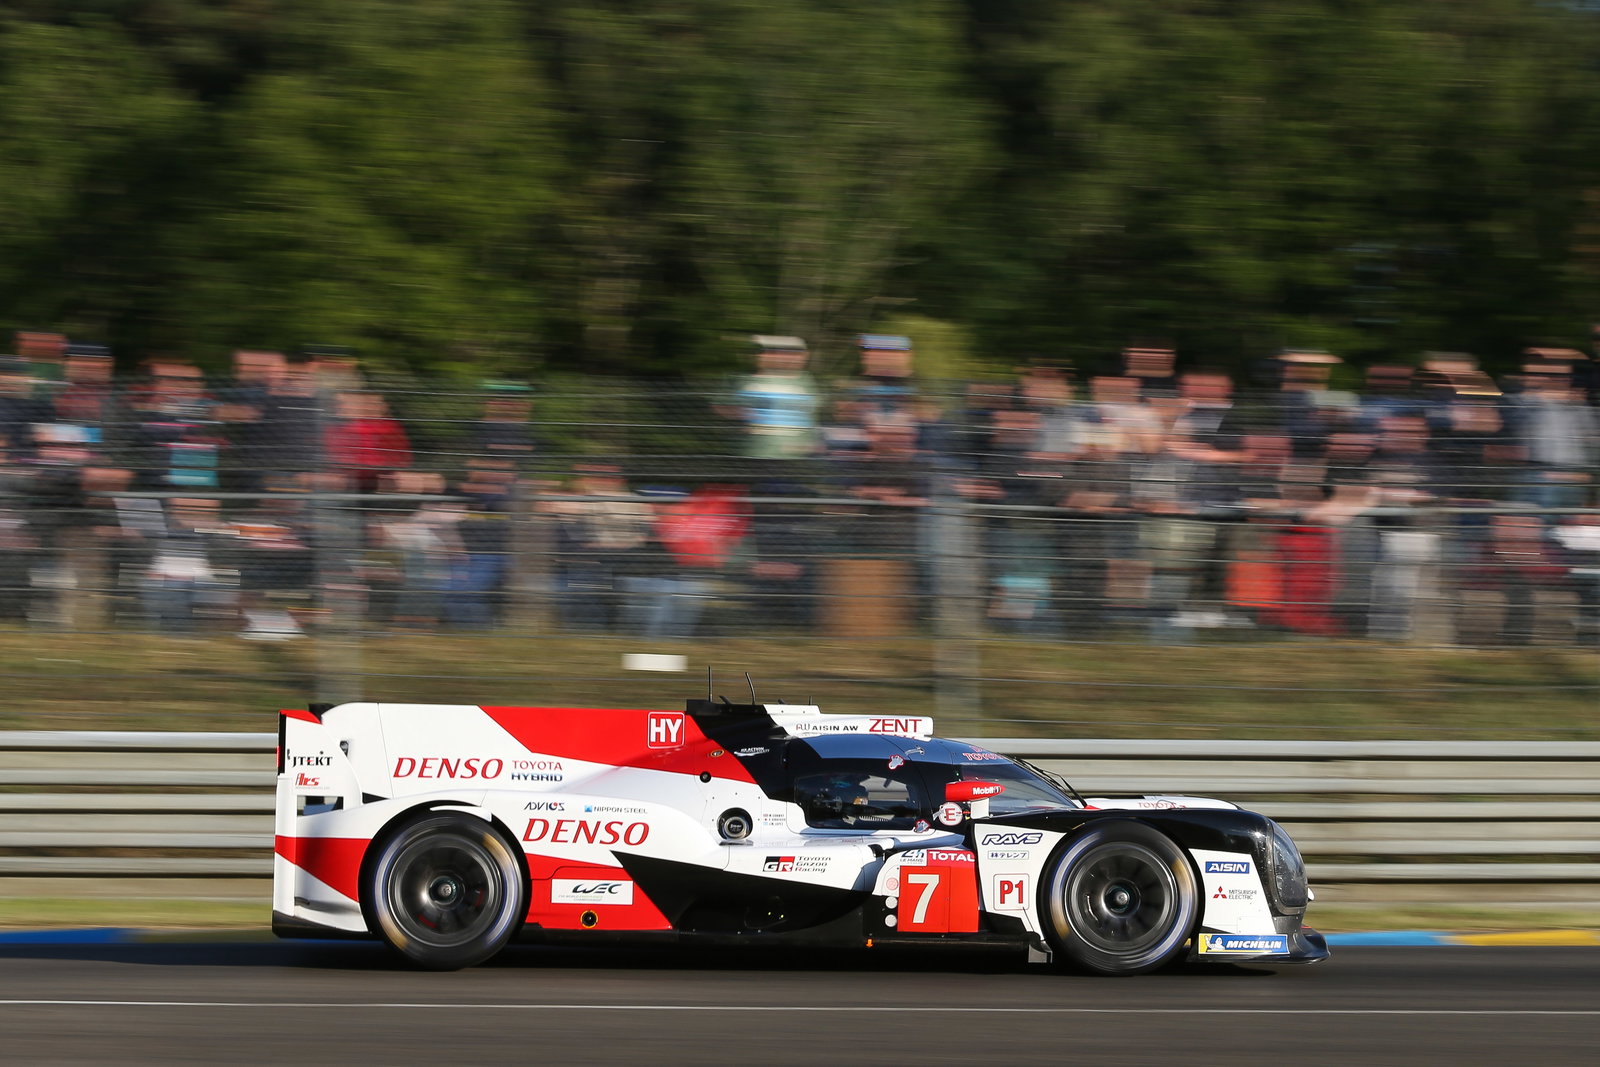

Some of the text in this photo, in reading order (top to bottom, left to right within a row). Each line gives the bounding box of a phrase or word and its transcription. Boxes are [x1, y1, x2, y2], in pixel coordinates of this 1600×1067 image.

[650, 718, 682, 743] HY
[869, 718, 922, 733] ZENT
[292, 756, 333, 768] JTEKT
[393, 757, 504, 779] DENSO
[512, 760, 563, 771] TOYOTA
[511, 772, 563, 782] HYBRID
[944, 808, 957, 821] E
[522, 818, 650, 846] DENSO
[982, 832, 1044, 846] RAYS
[929, 850, 976, 863] TOTAL
[762, 861, 795, 873] GR
[1208, 863, 1248, 873] AISIN
[572, 883, 623, 895] WEC
[1000, 880, 1024, 905] P1
[907, 873, 941, 924] 7
[1226, 940, 1282, 949] MICHELIN
